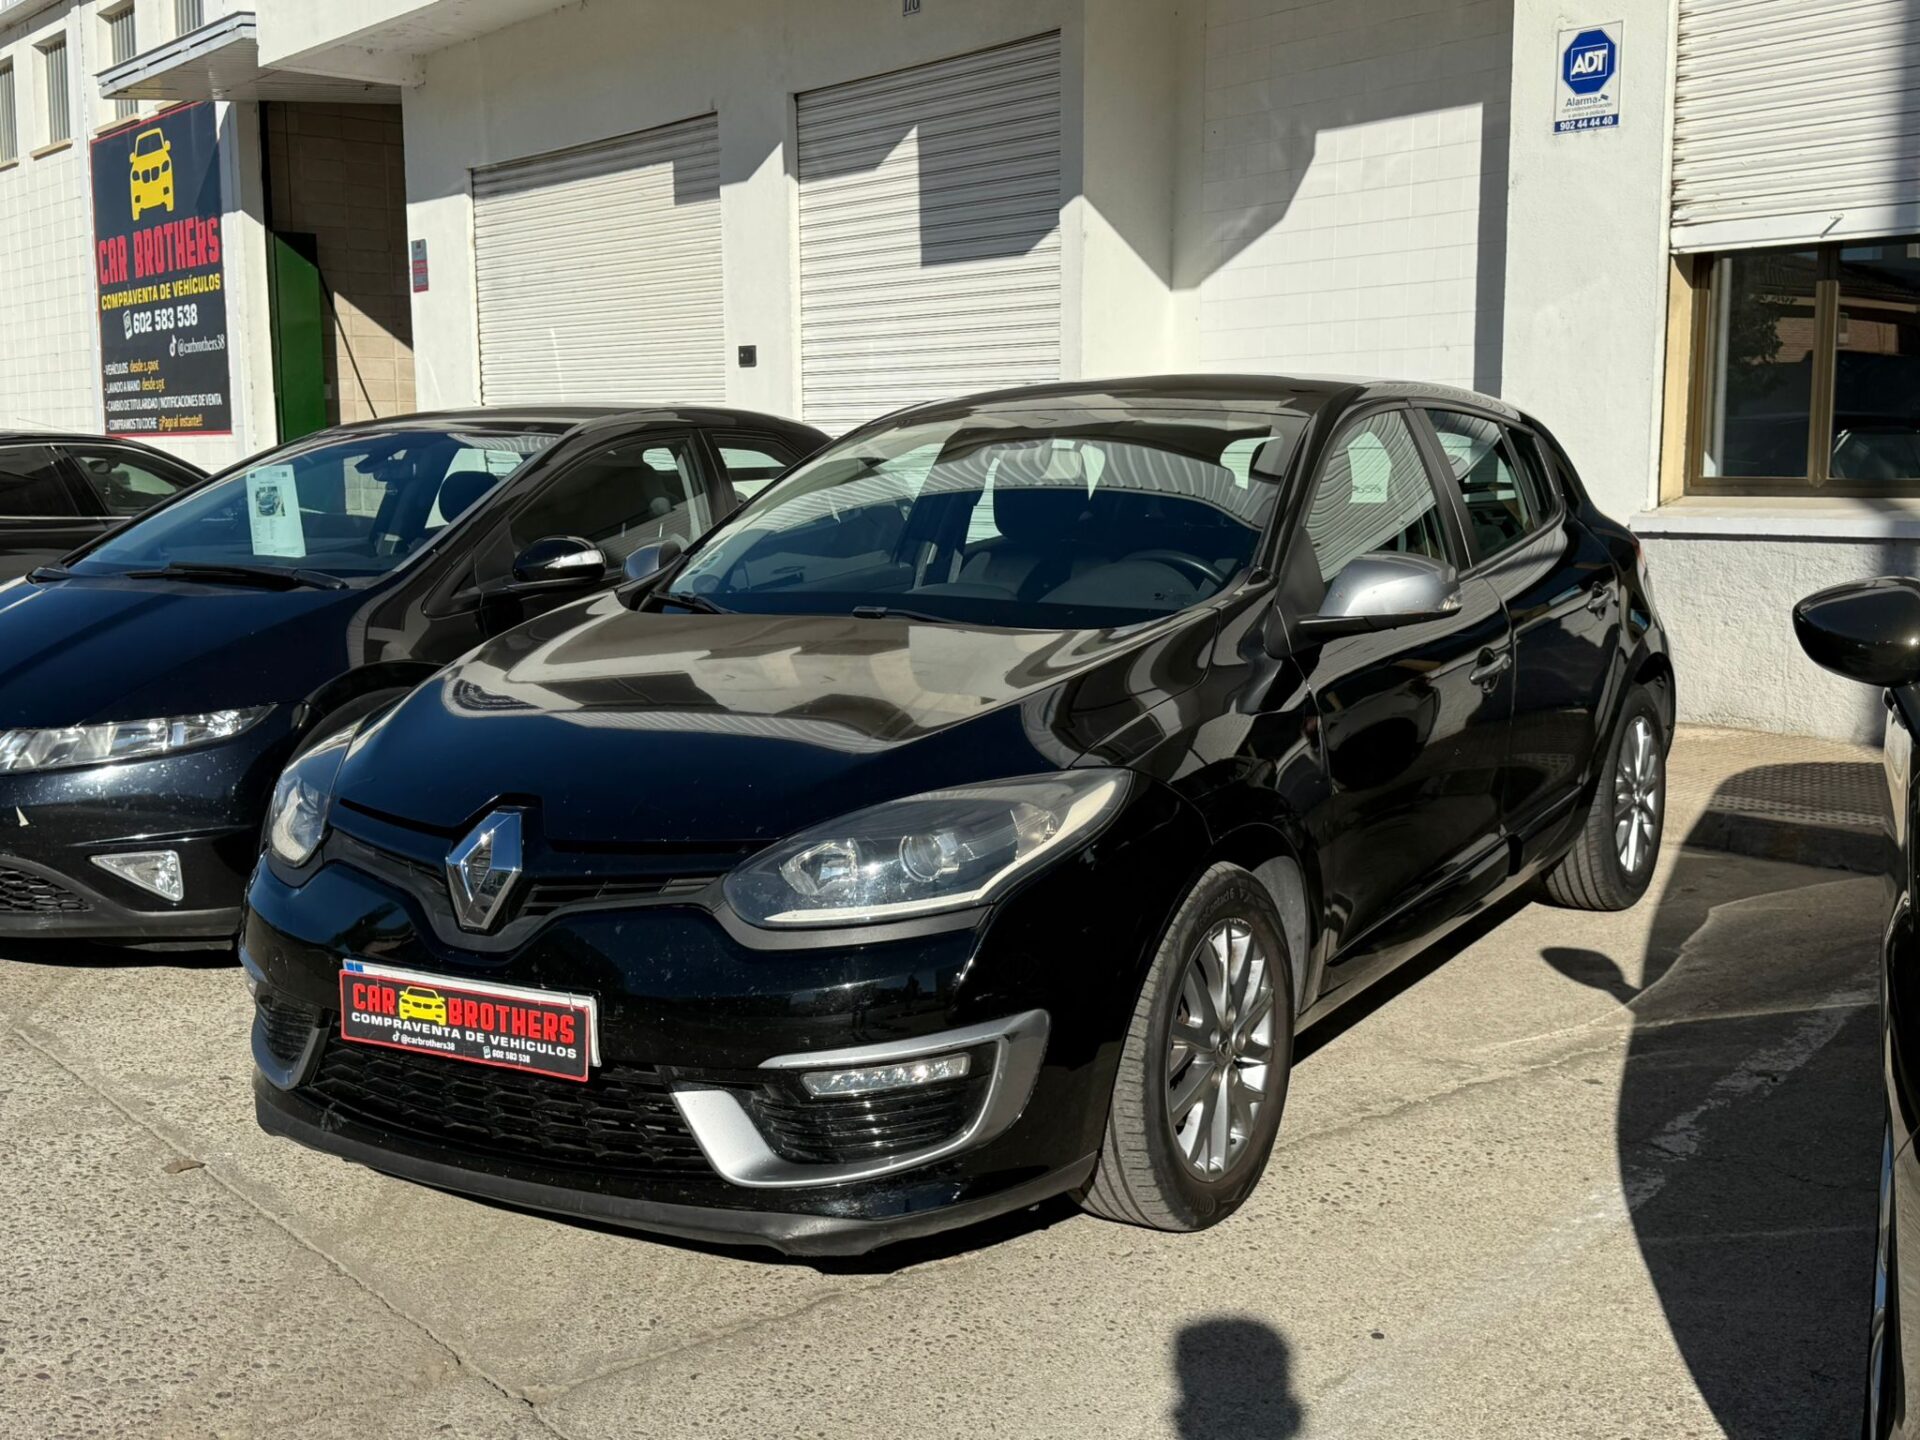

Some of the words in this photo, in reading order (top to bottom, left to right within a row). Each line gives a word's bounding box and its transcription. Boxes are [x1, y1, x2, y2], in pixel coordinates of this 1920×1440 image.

[1571, 49, 1608, 75] ADT
[1566, 96, 1597, 107] Alarma
[1560, 121, 1575, 131] 902
[1577, 119, 1588, 129] 44
[1589, 117, 1600, 127] 44
[1602, 115, 1613, 125] 40
[98, 235, 128, 285] CAR
[132, 215, 220, 279] BROTHERS
[101, 285, 159, 310] COMPRAVENTA
[159, 282, 171, 300] DE
[172, 273, 221, 297] VEHÍCULOS
[133, 311, 153, 334] 602
[154, 307, 174, 331] 583
[176, 303, 198, 328] 538
[177, 333, 225, 357] @carbrothers38
[352, 983, 396, 1015] CAR
[448, 997, 576, 1044] BROTHERS
[351, 1012, 461, 1040] COMPRAVENTA
[465, 1030, 485, 1044] DE
[490, 1034, 577, 1059] VEHÍCULOS
[400, 1033, 456, 1052] @carbrothers38
[492, 1049, 504, 1059] 602
[519, 1053, 530, 1064] 538
